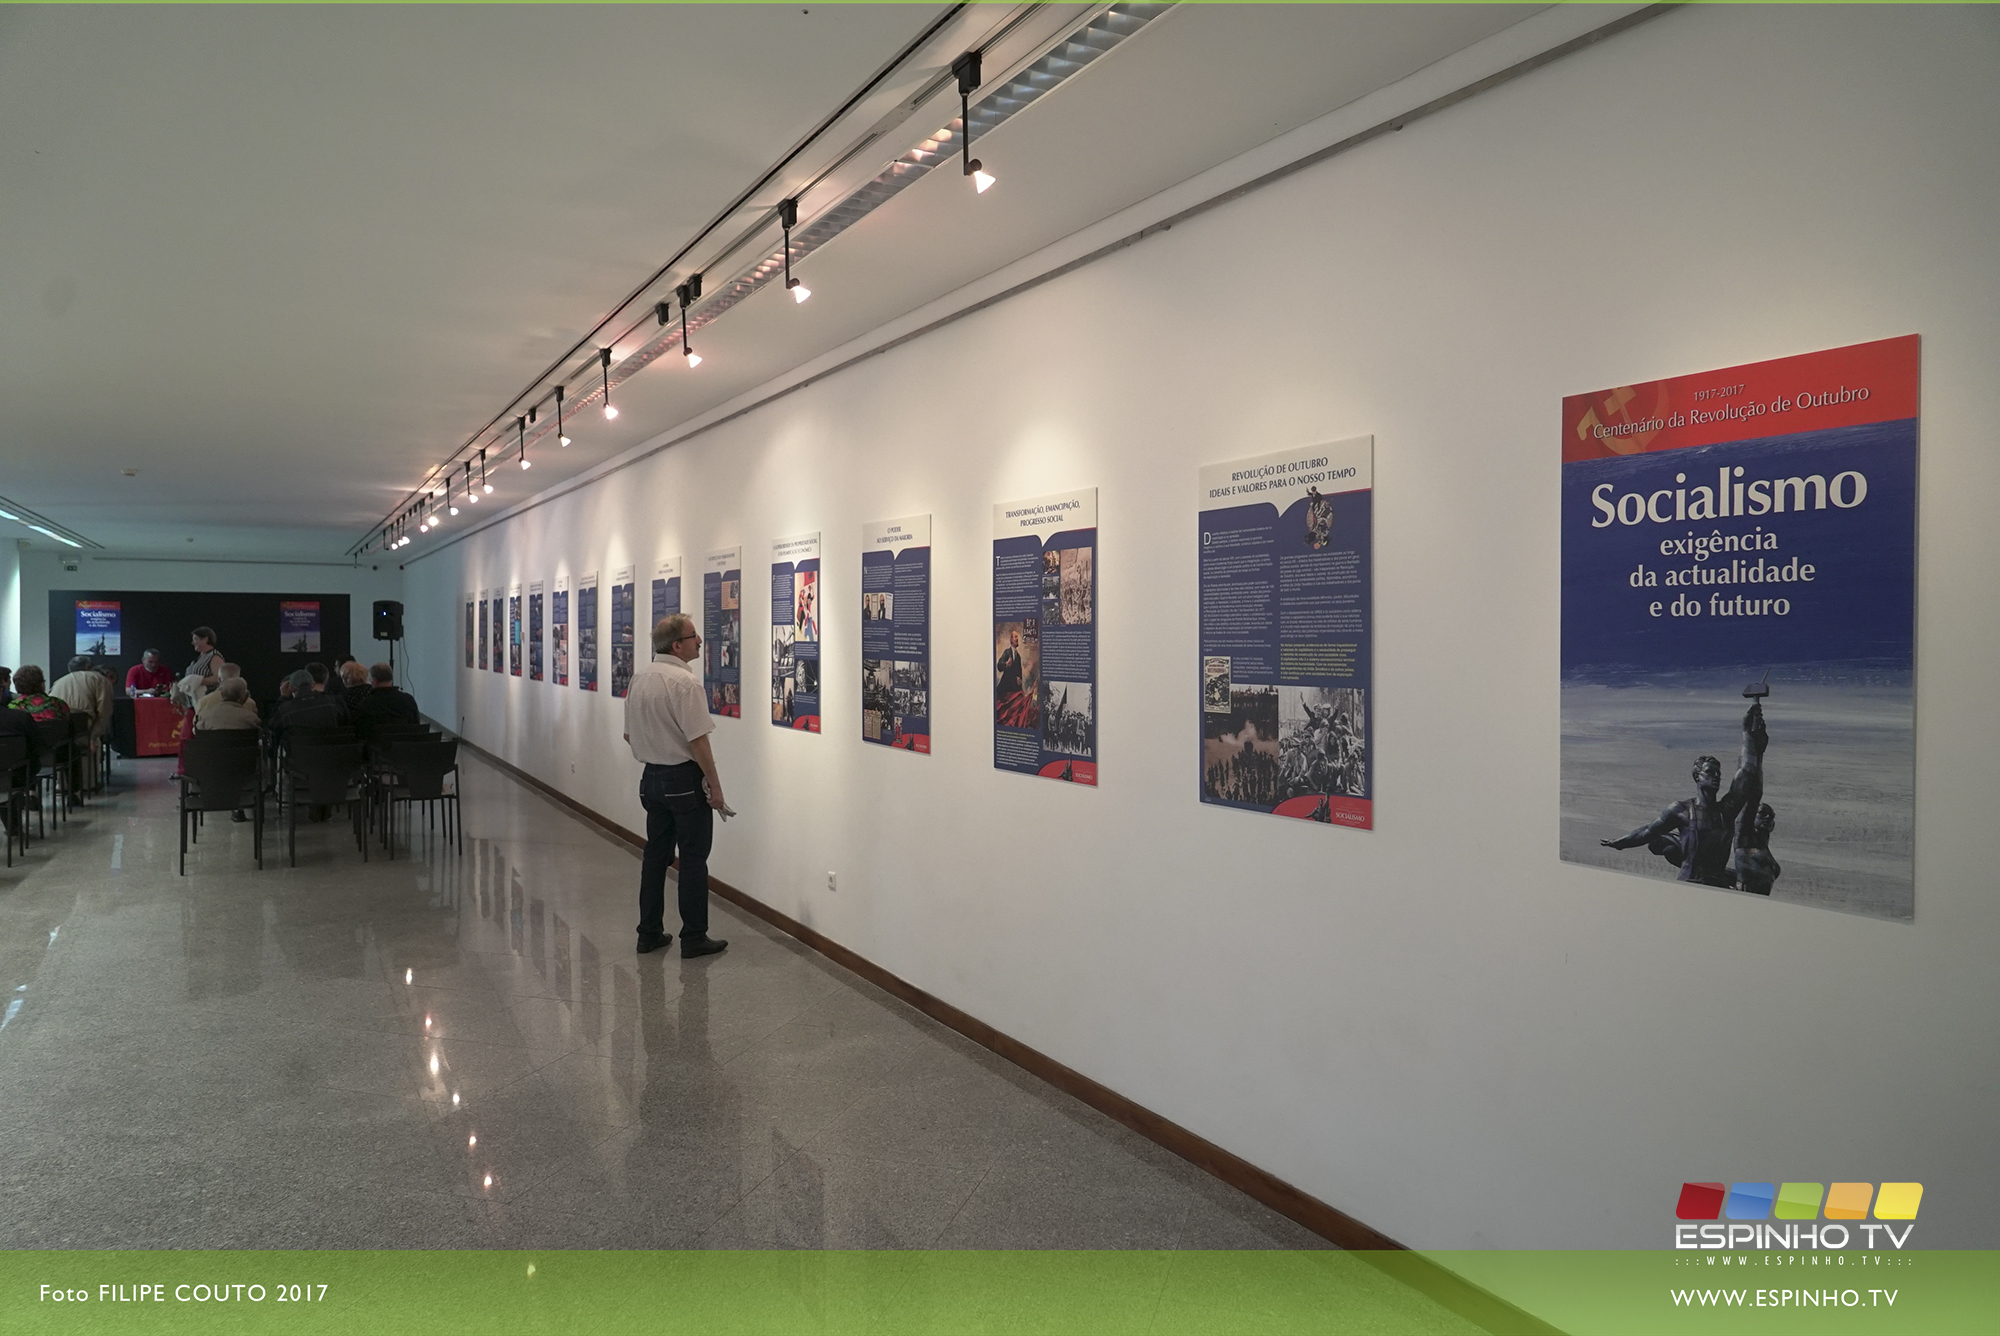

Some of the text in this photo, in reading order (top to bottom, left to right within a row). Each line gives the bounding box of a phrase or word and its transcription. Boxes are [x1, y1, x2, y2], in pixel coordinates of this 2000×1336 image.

[1693, 384, 1745, 401] 1917-2017
[1593, 385, 1871, 440] Centenário da Revolução de Outubro
[1209, 467, 1357, 499] IDEAIS E VALORES PARA O NOSSO TEMPO
[1231, 457, 1329, 482] REVOLUÇÃO DE OUTUBRO
[1591, 465, 1868, 528] Socialismo
[1659, 526, 1779, 562] exigência
[1629, 556, 1816, 588] da actualidade
[1649, 592, 1791, 618] e do futuro
